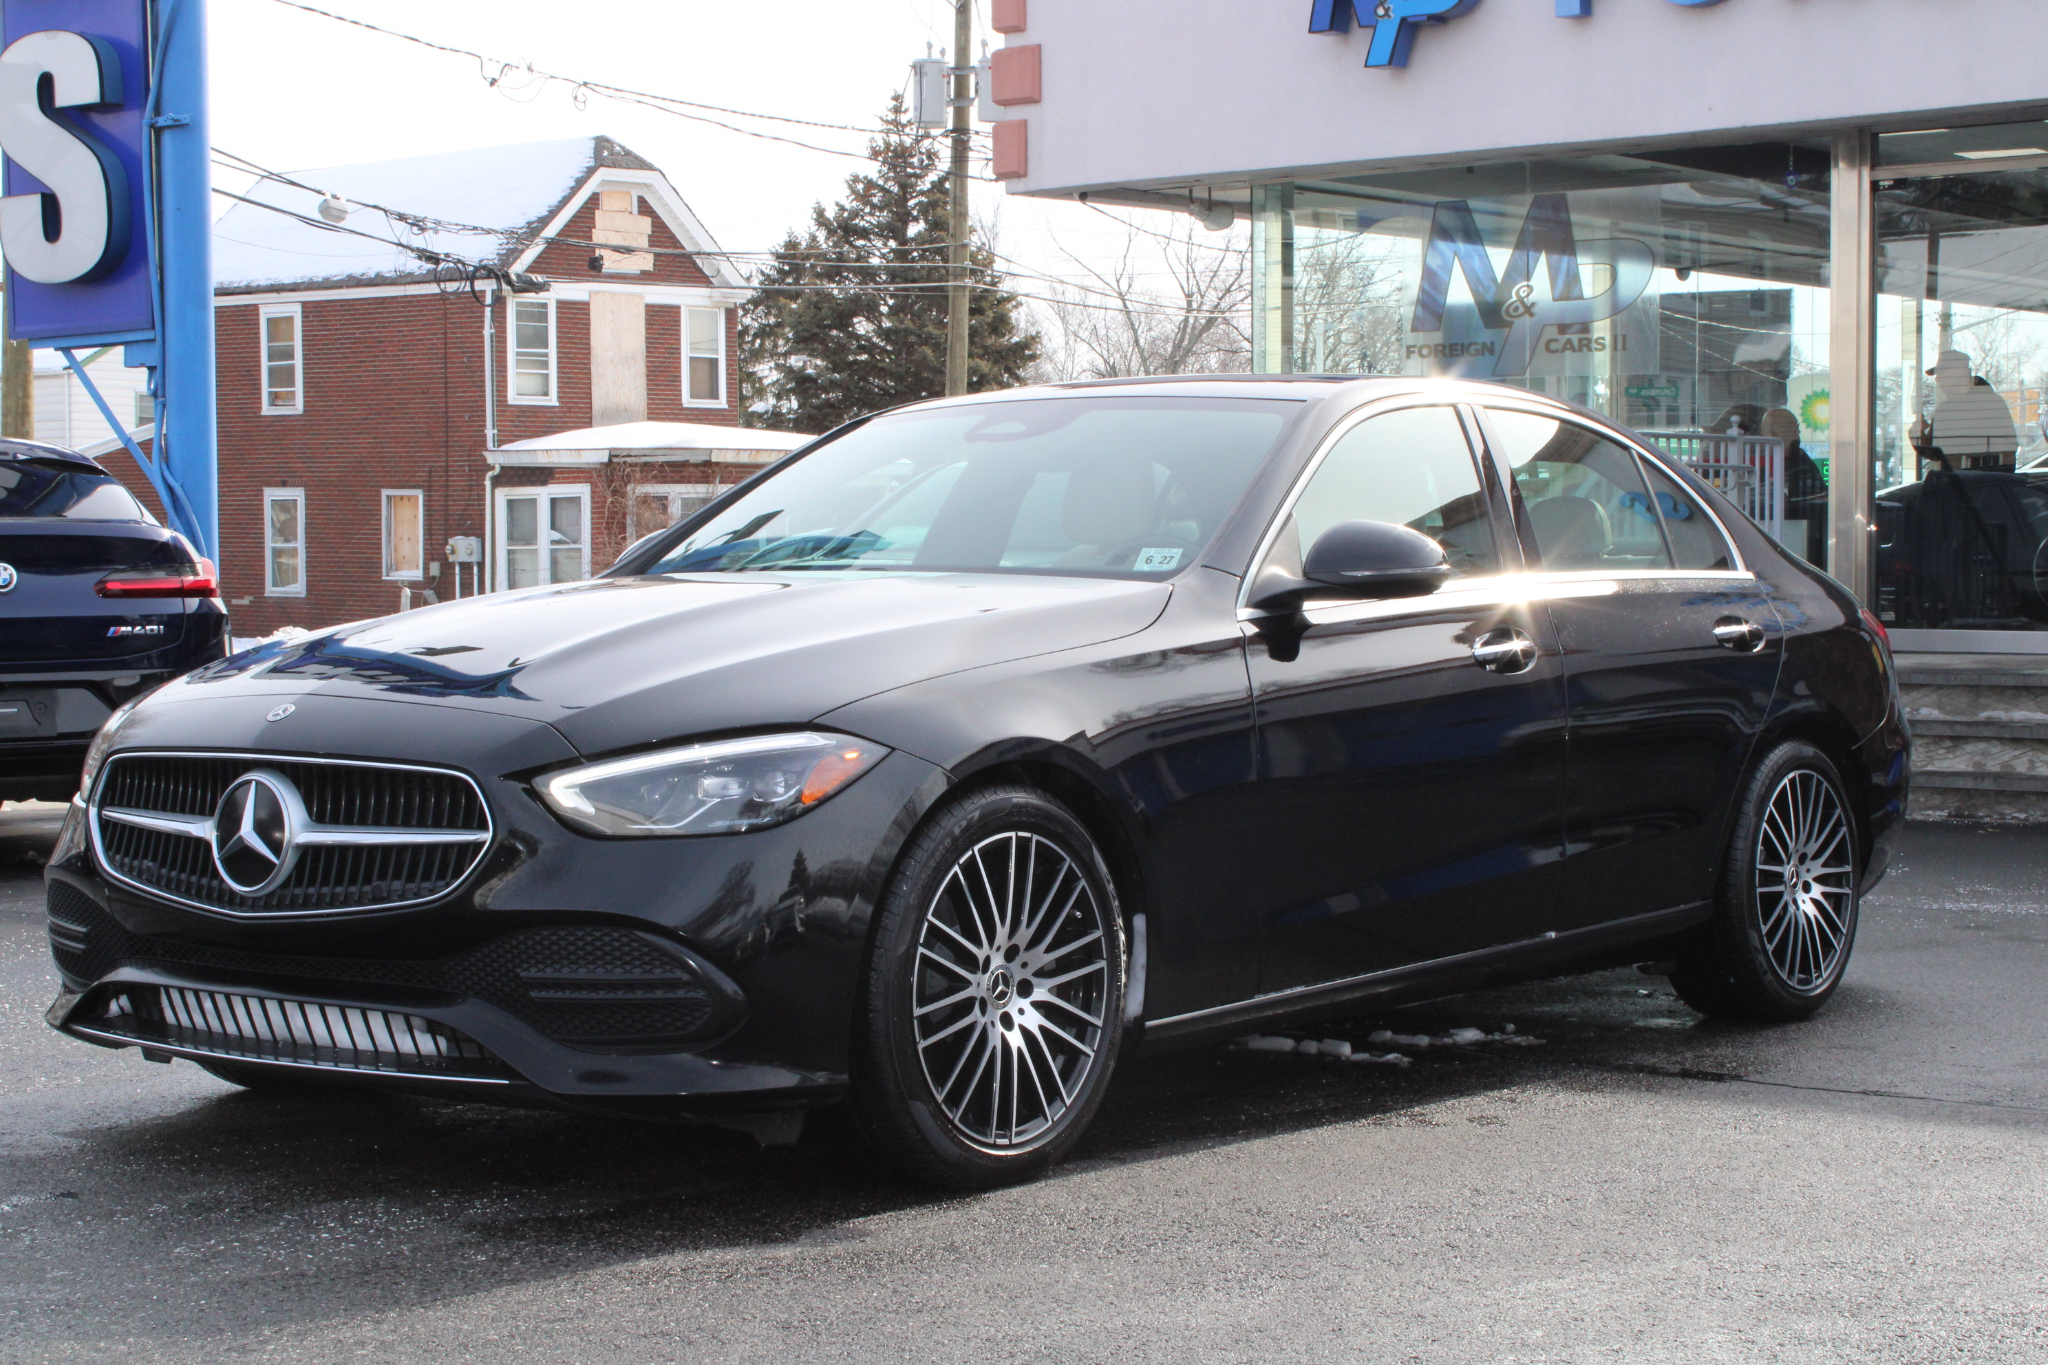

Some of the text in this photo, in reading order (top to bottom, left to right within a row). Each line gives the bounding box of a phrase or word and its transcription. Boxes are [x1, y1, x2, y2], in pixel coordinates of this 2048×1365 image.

[0, 30, 120, 284] S
[1405, 334, 1628, 360] FOREIGN CARS II
[1145, 555, 1175, 565] 6 27
[118, 625, 165, 636] M40i
[953, 808, 981, 835] P7
